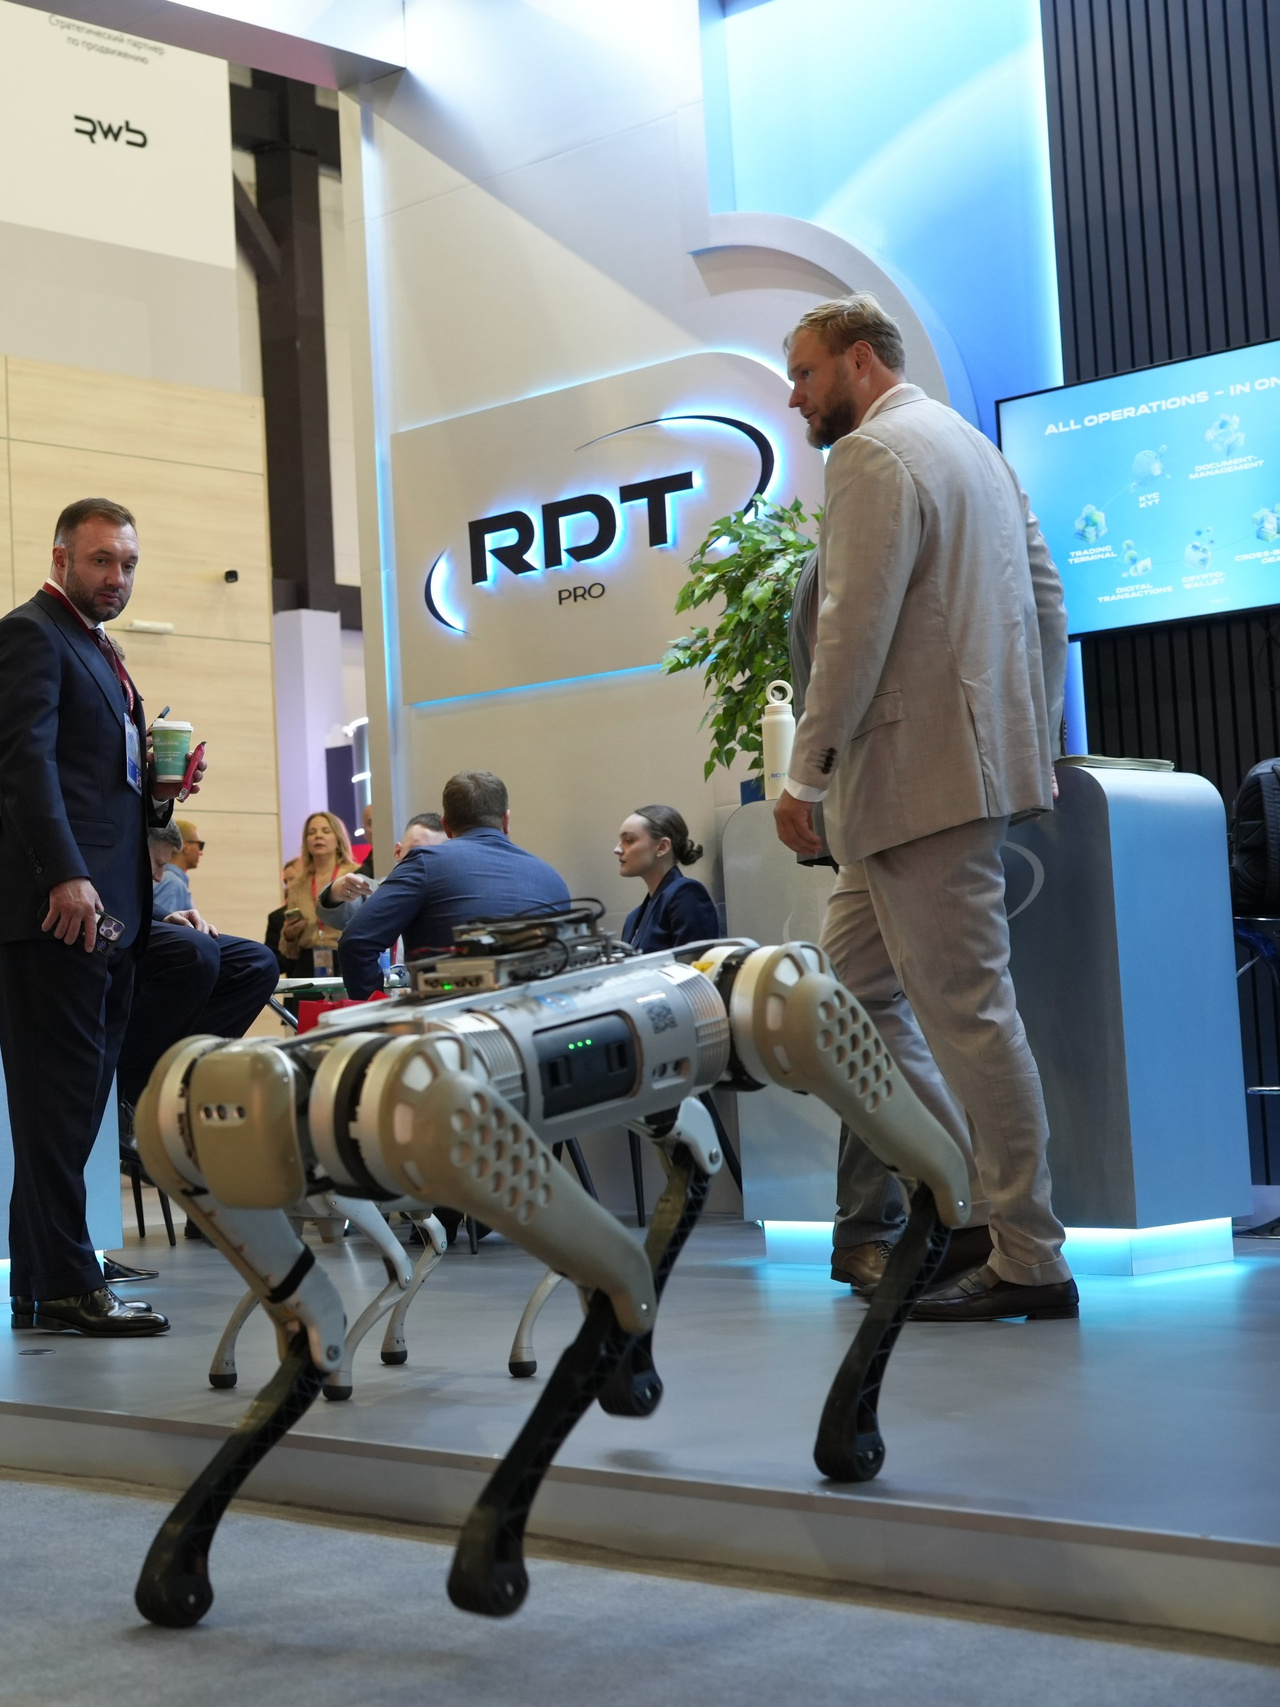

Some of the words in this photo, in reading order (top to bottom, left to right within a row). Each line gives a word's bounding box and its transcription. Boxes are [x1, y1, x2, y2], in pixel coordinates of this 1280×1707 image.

[1044, 419, 1082, 436] ALL
[1083, 390, 1210, 427] OPERATIONS
[1230, 381, 1251, 396] IN
[1188, 460, 1265, 480] MANAGEMENT
[1138, 492, 1160, 502] KYC
[1138, 499, 1160, 508] KYT
[468, 470, 694, 585] RDT
[1067, 551, 1118, 565] TERMINAL
[1069, 545, 1112, 558] TRADING
[1116, 583, 1154, 595] DIGITAL
[1183, 577, 1226, 590] WALLET
[558, 582, 605, 605] PRO
[1097, 586, 1174, 603] TRANSACTIONS
